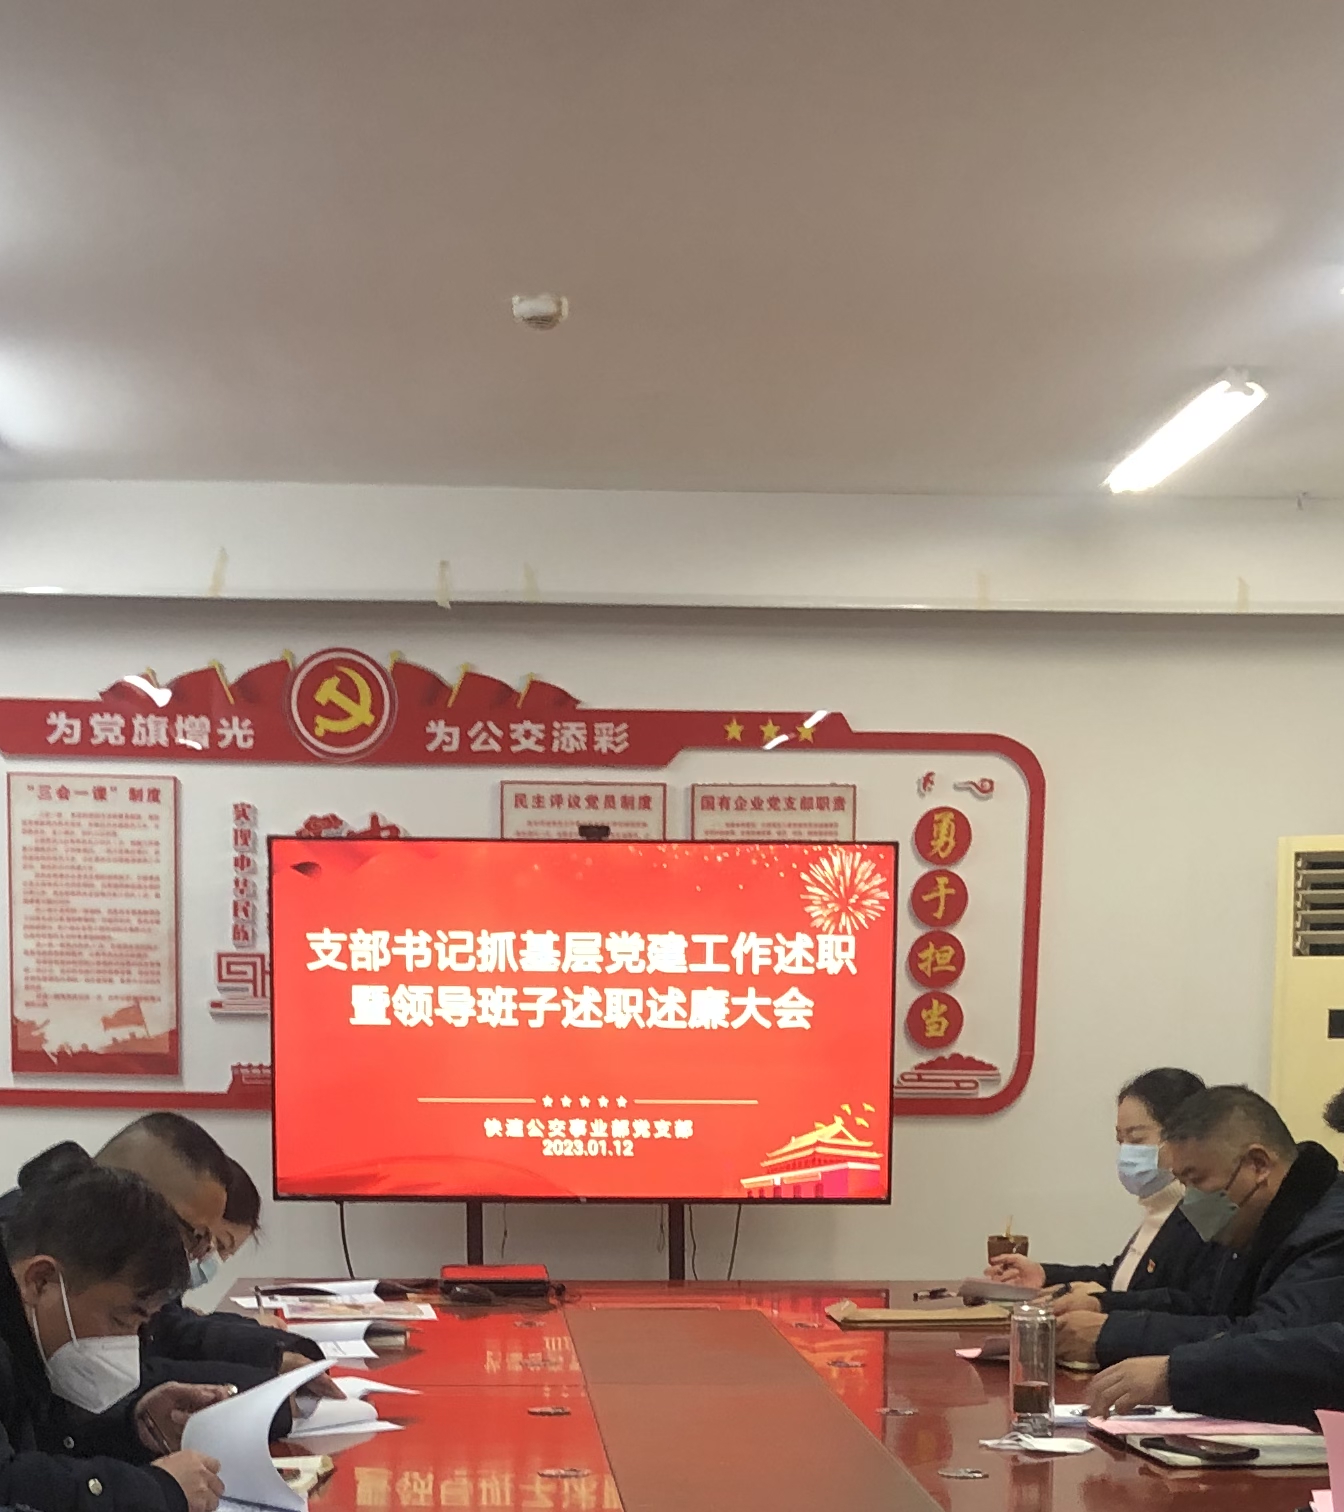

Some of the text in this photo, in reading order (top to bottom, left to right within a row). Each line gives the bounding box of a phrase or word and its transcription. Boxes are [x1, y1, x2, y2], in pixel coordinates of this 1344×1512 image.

[46, 711, 255, 750] 为党旗增光
[425, 719, 630, 754] 为公交添彩
[514, 793, 652, 811] 民主评议党员制度
[700, 794, 846, 812] 国有企业党支部职责
[917, 811, 957, 1038] 勇于担当
[306, 928, 857, 975] 支部书记抓基层党建工作述职
[350, 985, 814, 1030] 暨领导班子述职述廉大会
[484, 1118, 694, 1139] 快速公交事业部党支部
[542, 1140, 633, 1157] 2023.01.12
